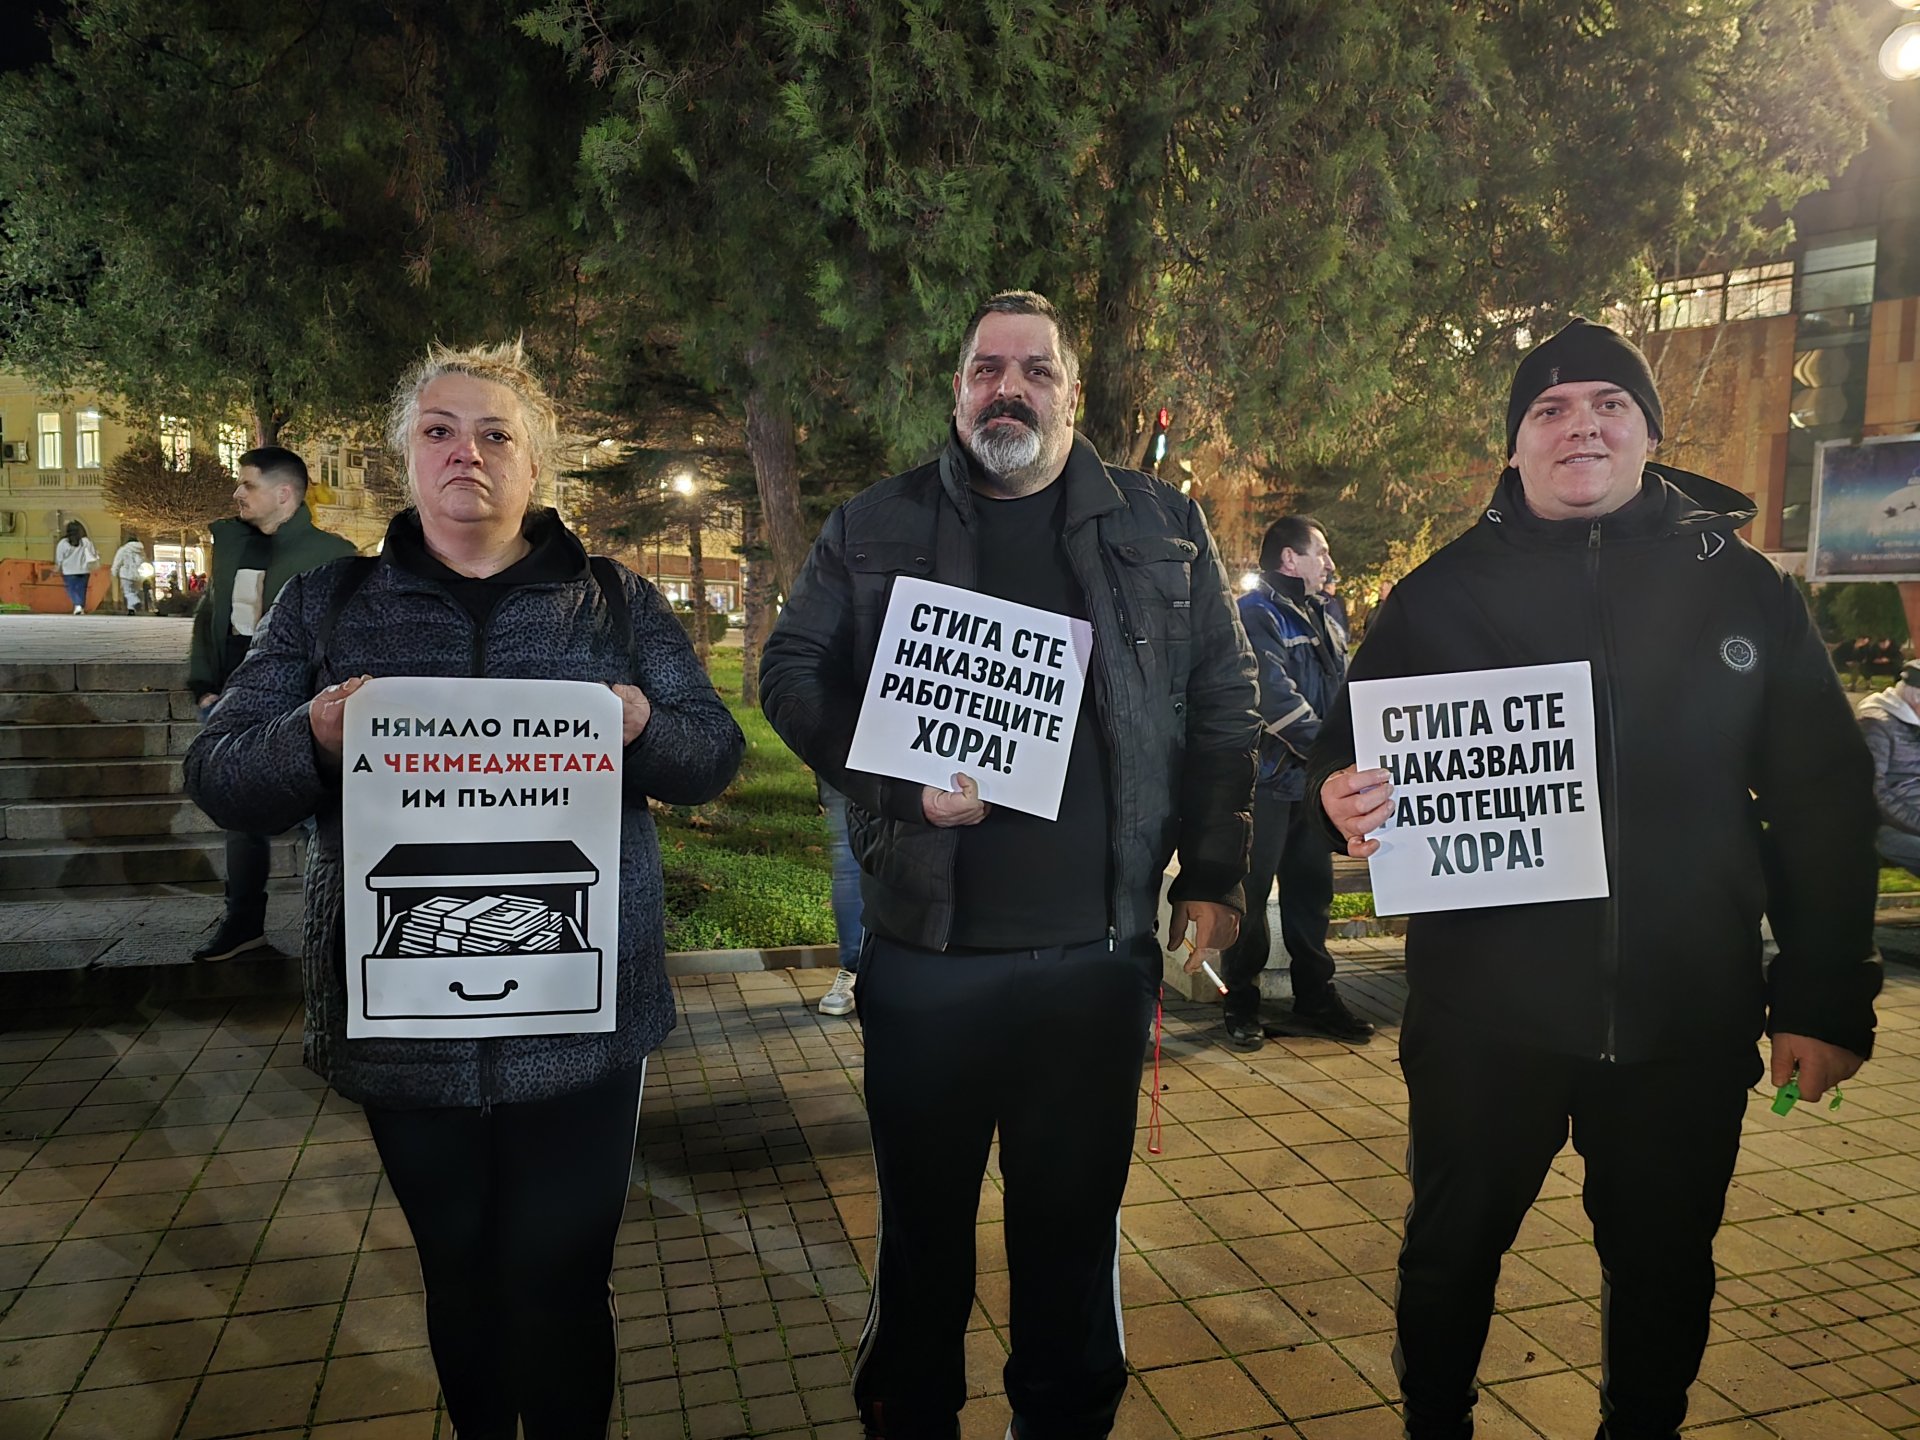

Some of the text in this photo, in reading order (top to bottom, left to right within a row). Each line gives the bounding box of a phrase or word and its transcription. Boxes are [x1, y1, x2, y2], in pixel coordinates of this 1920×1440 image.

[910, 603, 1066, 669] СТИГА СТЕ
[894, 638, 1064, 705] НАКАЗВАЛИ
[371, 717, 599, 739] НЯМАЛО ПАРИ,
[879, 672, 1063, 742] РАБОТЕЩИТЕ
[1381, 692, 1565, 742] СТИГА СТЕ
[352, 753, 614, 773] А ЧЕКМЕДЖЕТАТА
[909, 715, 1017, 774] ХОРА!
[1379, 738, 1574, 786] НАКАЗВАЛИ
[402, 787, 569, 807] ИМ ПЪЛНИ!
[1380, 781, 1584, 827] АБОТЕЩИТЕ
[1426, 827, 1544, 876] ХОРА!
